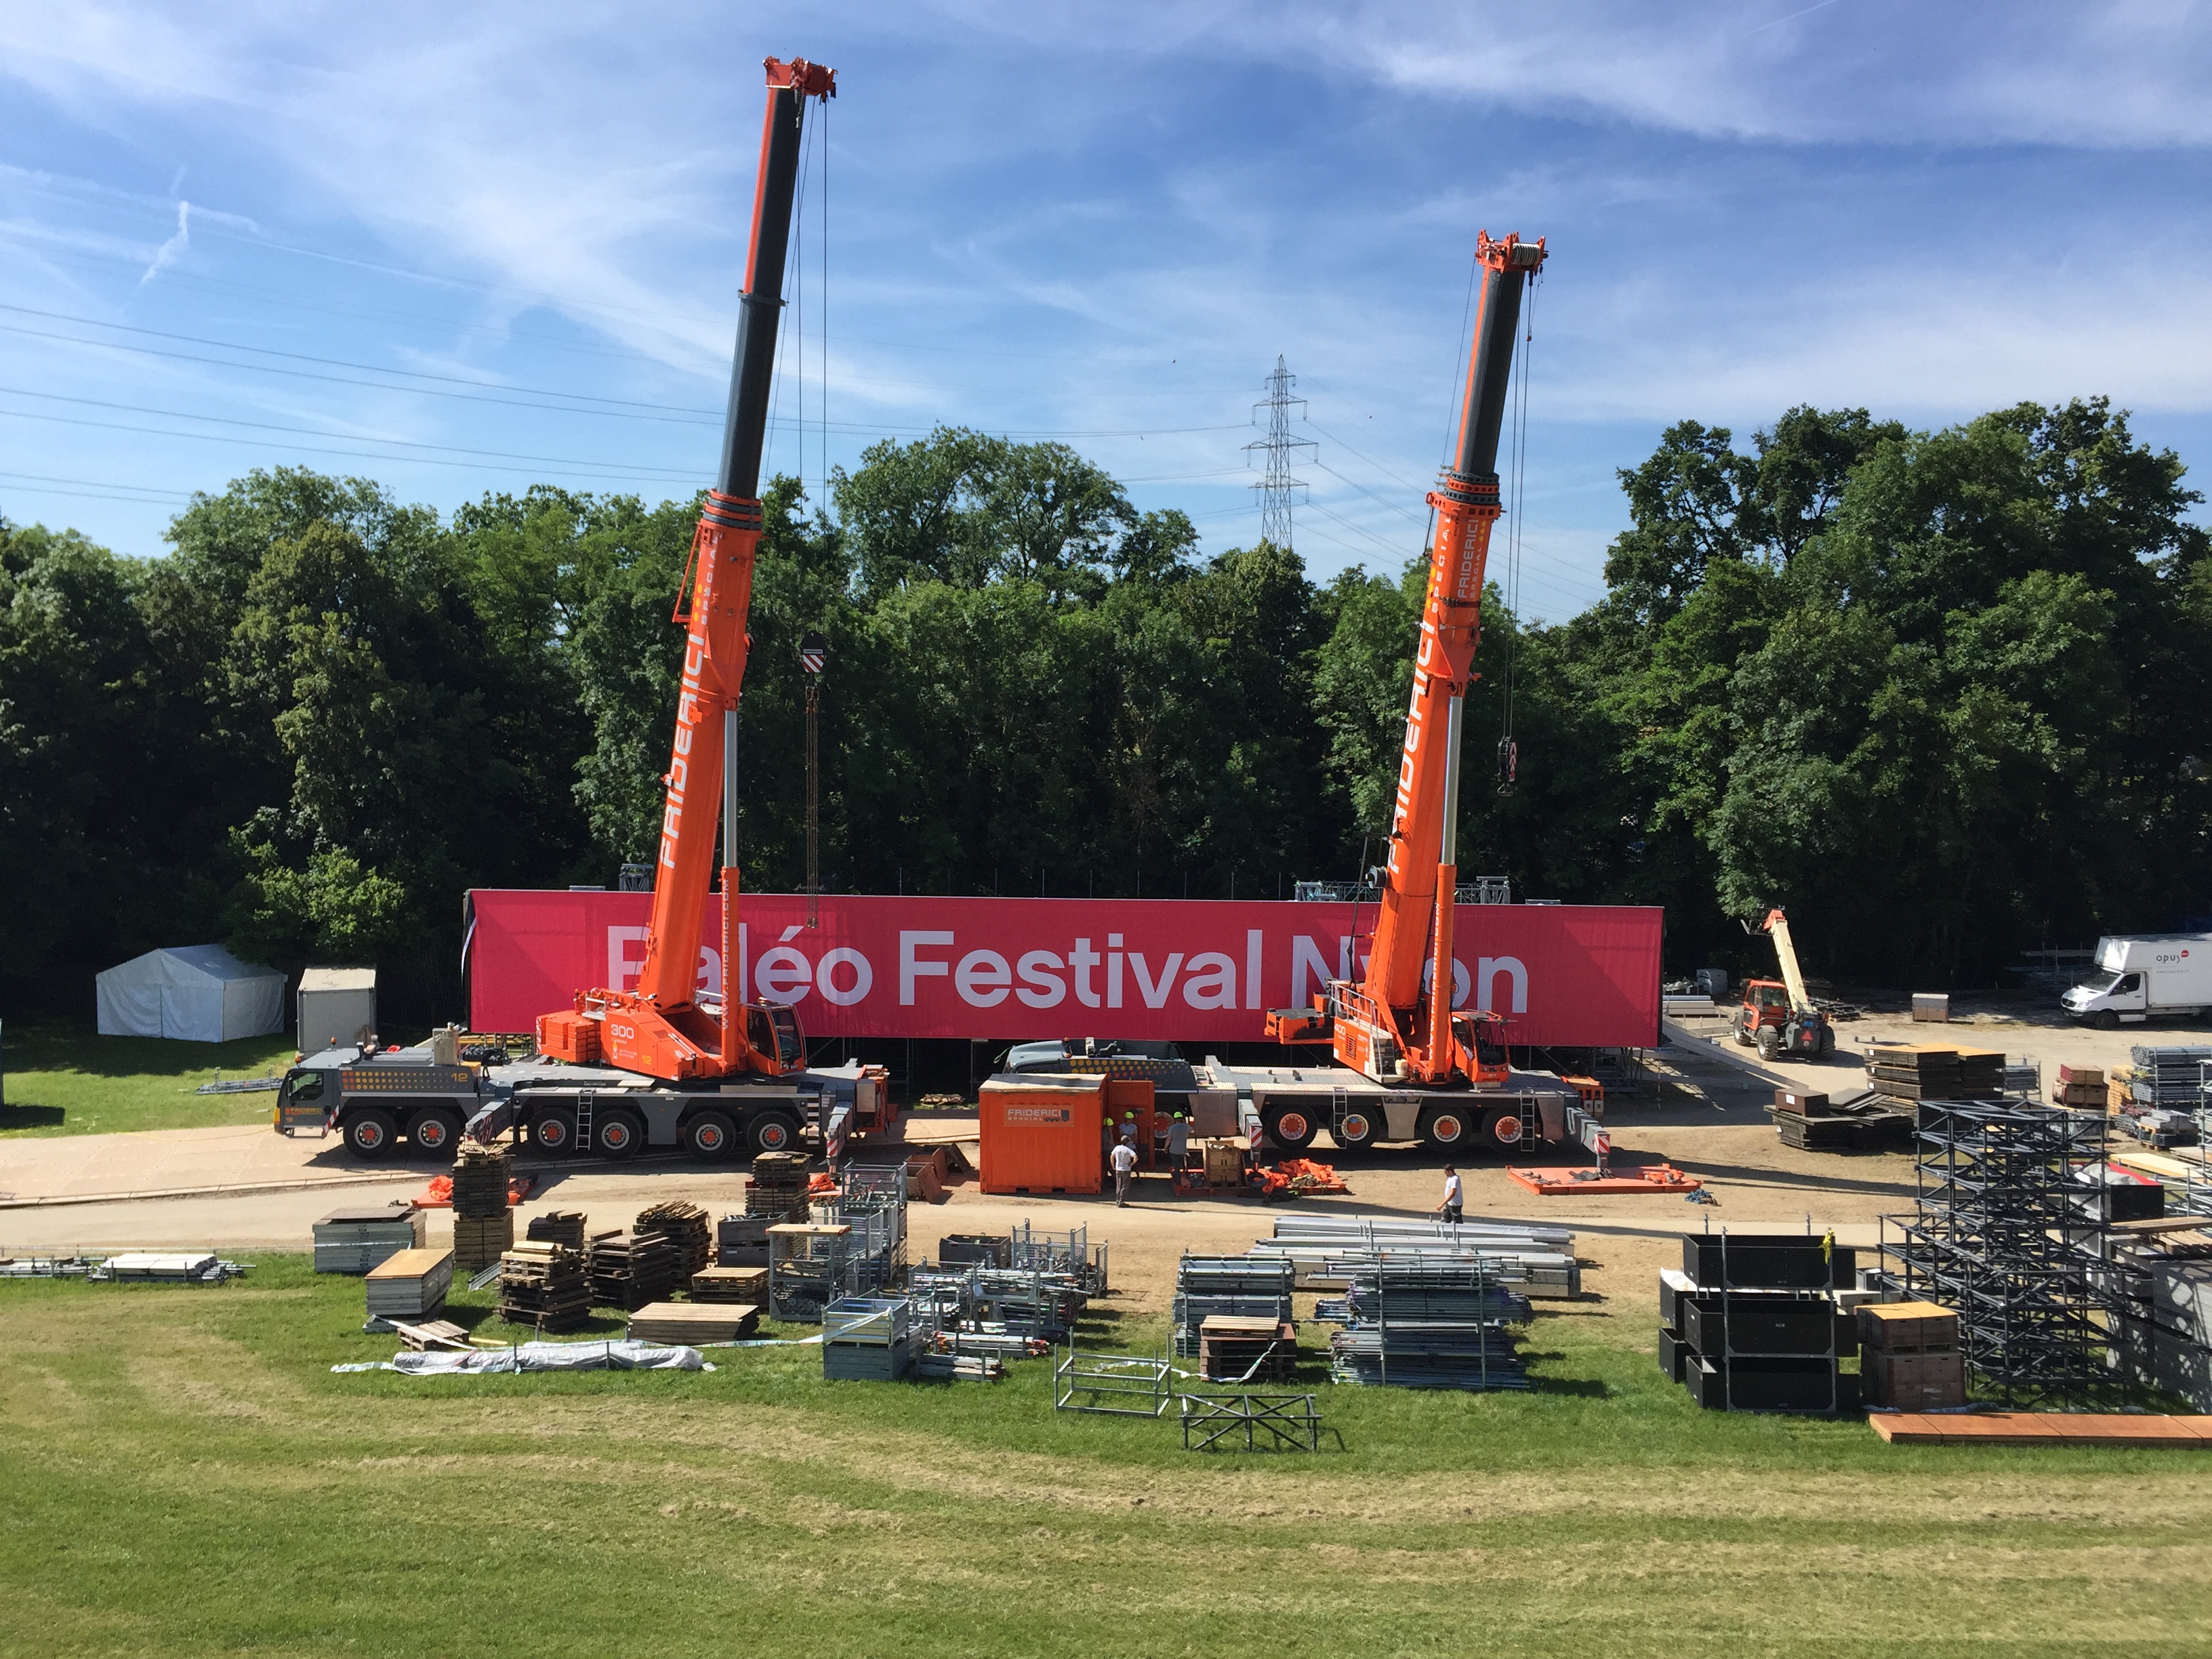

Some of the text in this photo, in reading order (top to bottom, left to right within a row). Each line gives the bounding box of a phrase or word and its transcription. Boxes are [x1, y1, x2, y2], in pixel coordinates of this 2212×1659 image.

[1431, 515, 1451, 614] SPECIAL
[1458, 519, 1479, 598] FRIDERICI
[660, 631, 706, 869] FRIDERICI
[2156, 955, 2180, 964] opus
[899, 929, 1263, 1010] Festival
[1291, 935, 1528, 1014] Non
[611, 1023, 634, 1040] 300
[641, 1054, 652, 1065] 12
[450, 1073, 468, 1082] 12
[1007, 1109, 1061, 1117] FRIDERICI
